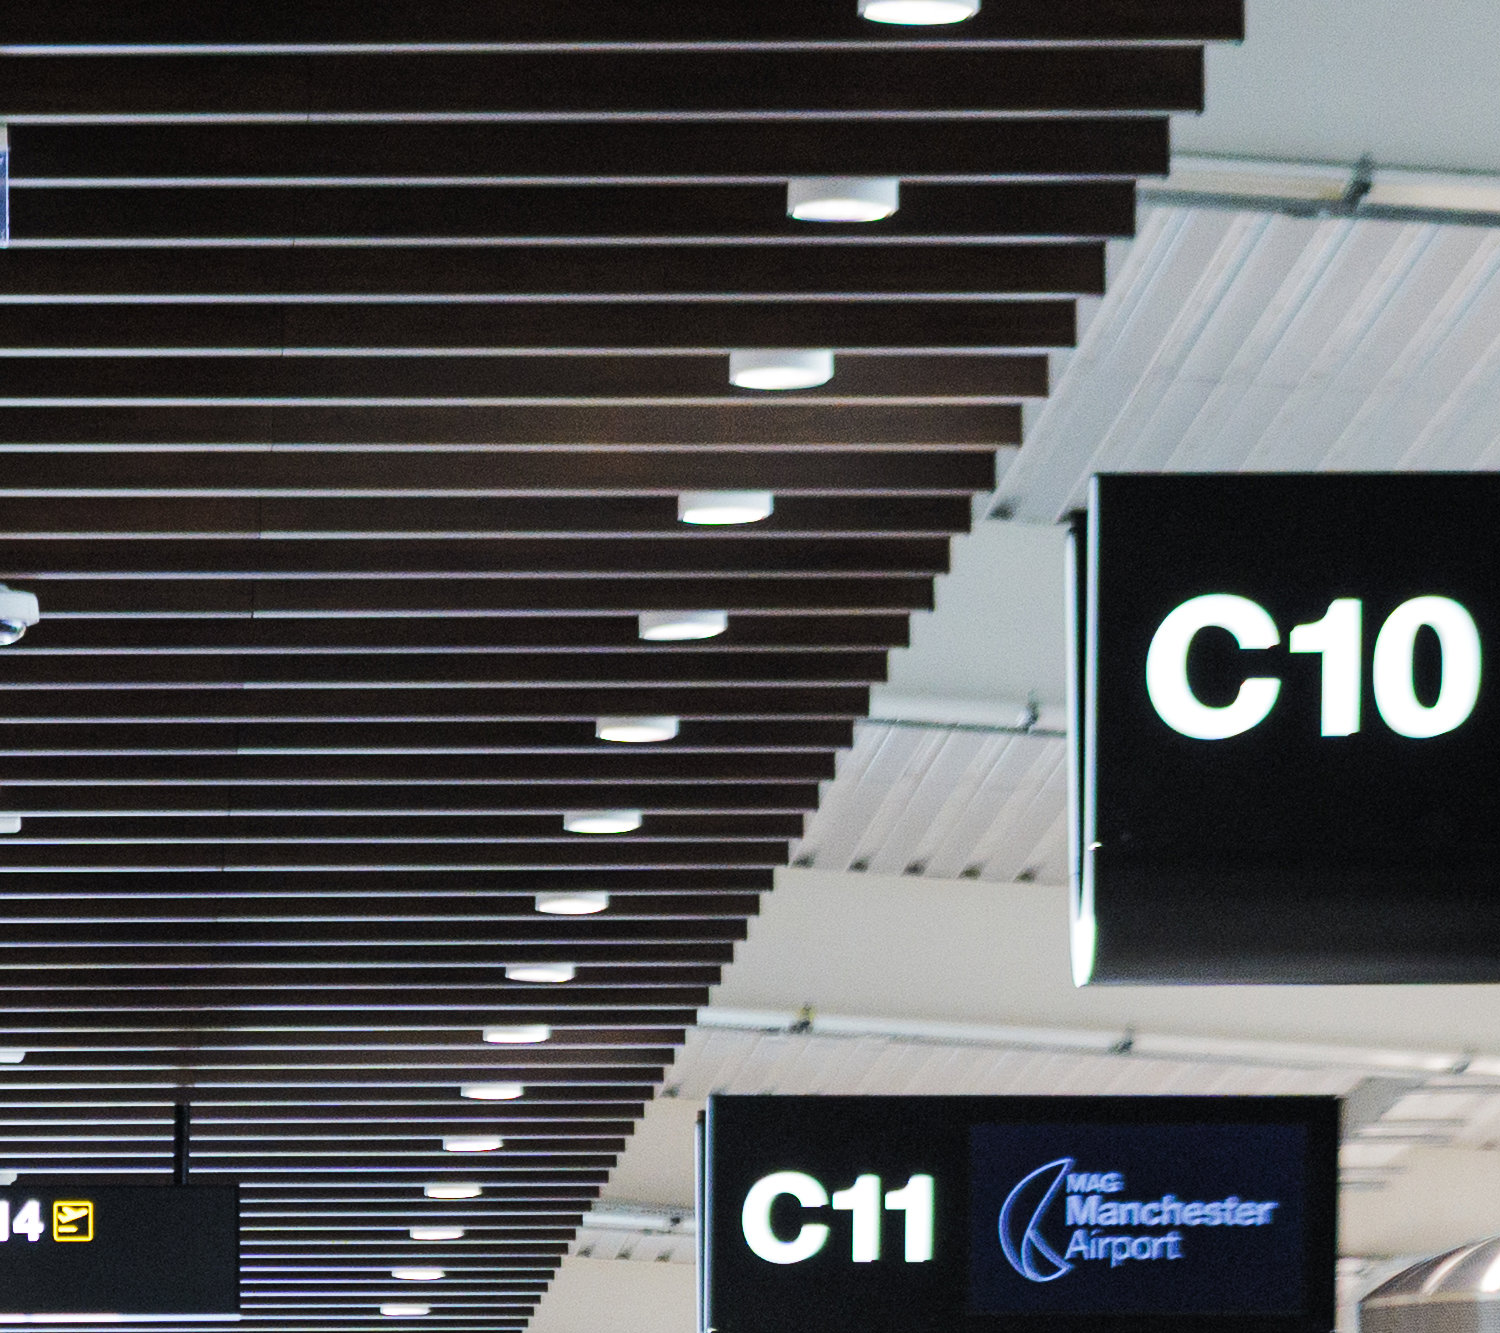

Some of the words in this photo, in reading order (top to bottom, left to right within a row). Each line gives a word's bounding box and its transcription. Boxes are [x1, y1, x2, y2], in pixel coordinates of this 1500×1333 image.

[1146, 593, 1483, 740] C10
[1066, 1172, 1125, 1193] MAG
[742, 1171, 934, 1264] C11
[1066, 1194, 1280, 1227] Manchester
[1065, 1229, 1185, 1269] Airport
